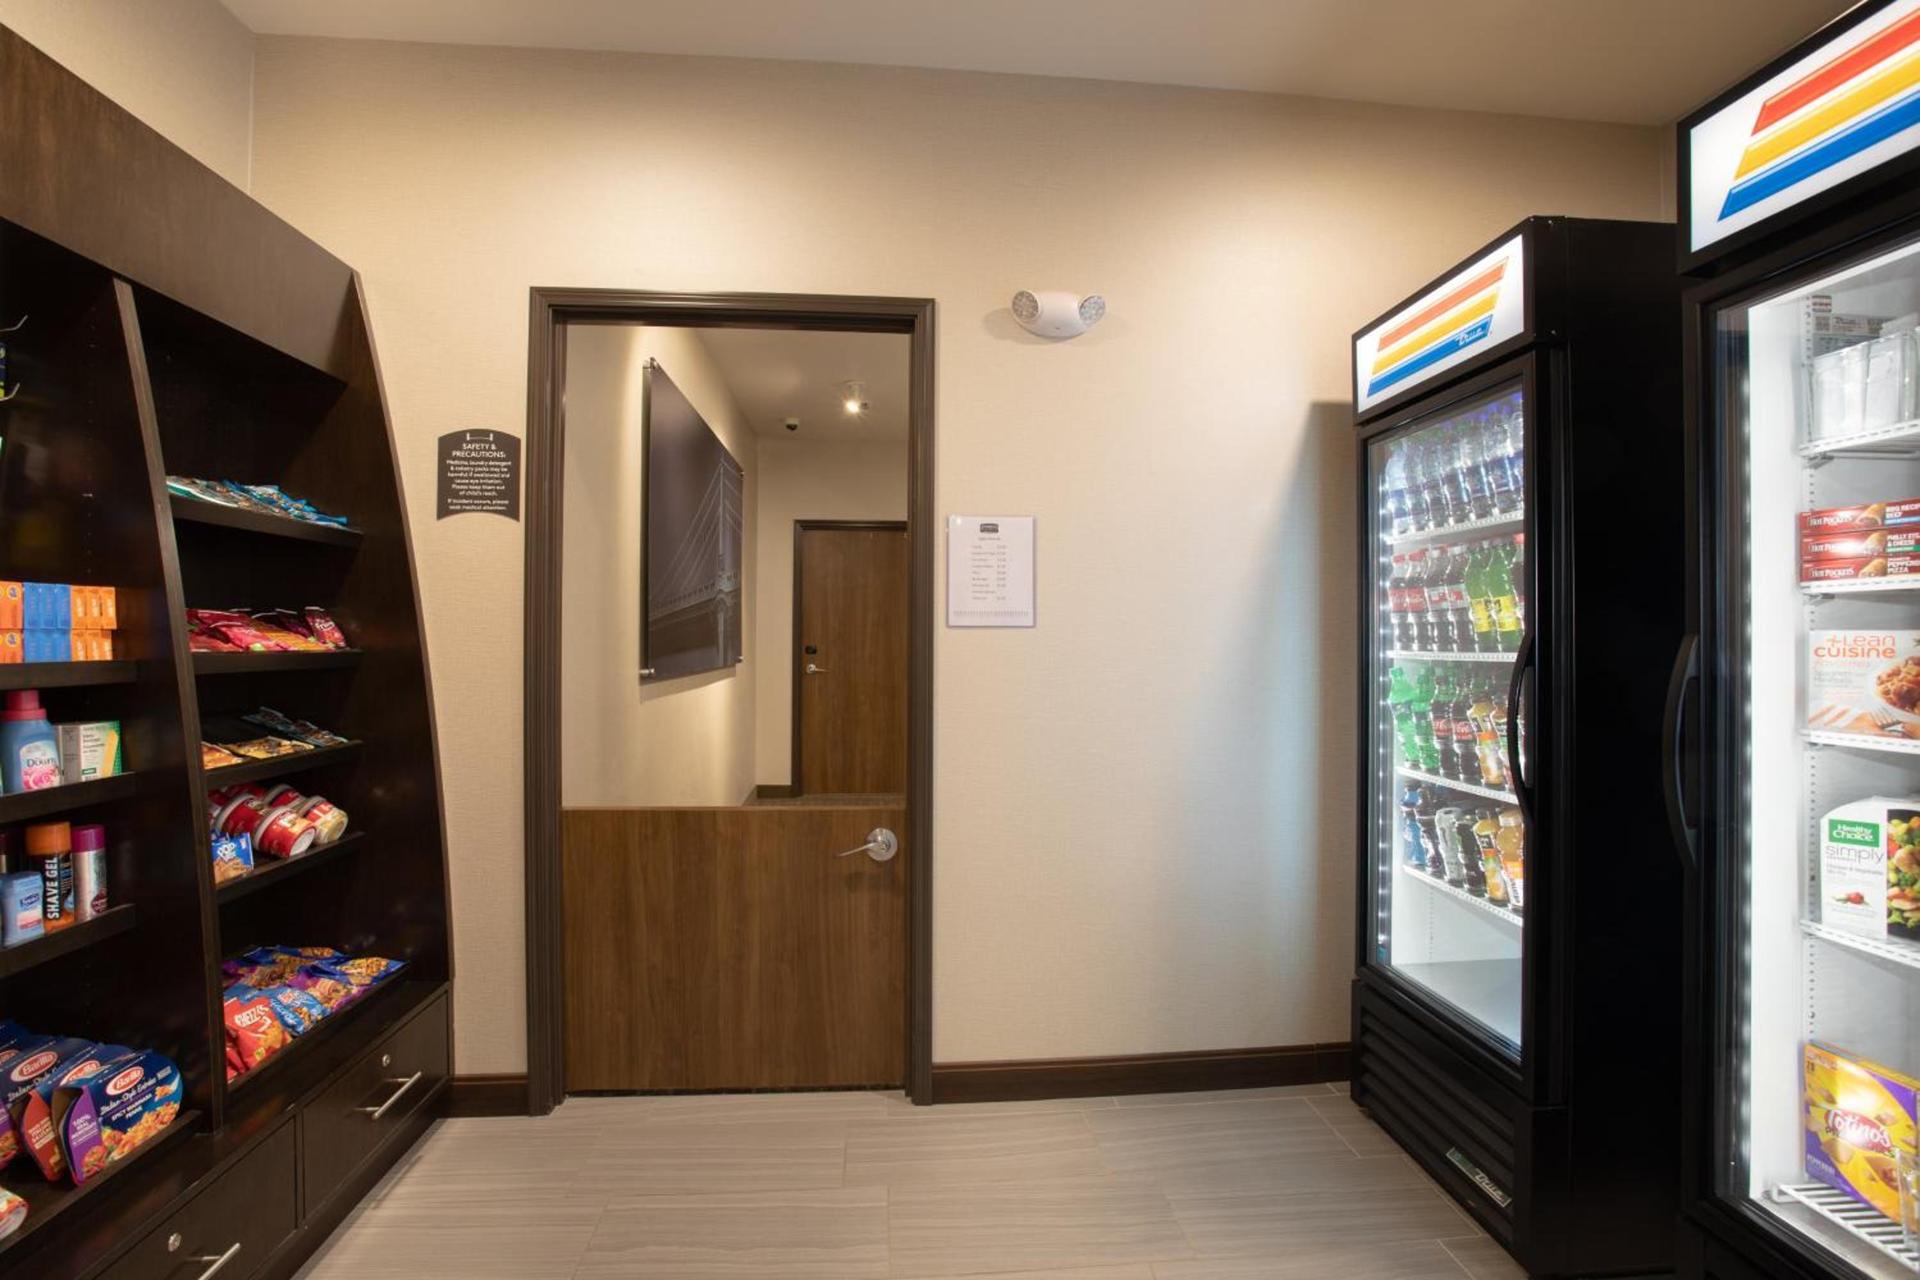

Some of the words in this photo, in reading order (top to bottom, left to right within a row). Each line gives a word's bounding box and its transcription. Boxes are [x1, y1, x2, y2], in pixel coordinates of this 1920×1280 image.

[1813, 646, 1896, 658] cuisine
[1832, 830, 1873, 841] Choice
[1836, 824, 1873, 834] Healthy
[1826, 845, 1884, 864] simply
[45, 857, 58, 878] GEL
[46, 881, 60, 919] SHAVE
[22, 1054, 53, 1075] Barilla
[1828, 1110, 1892, 1148] Totino's
